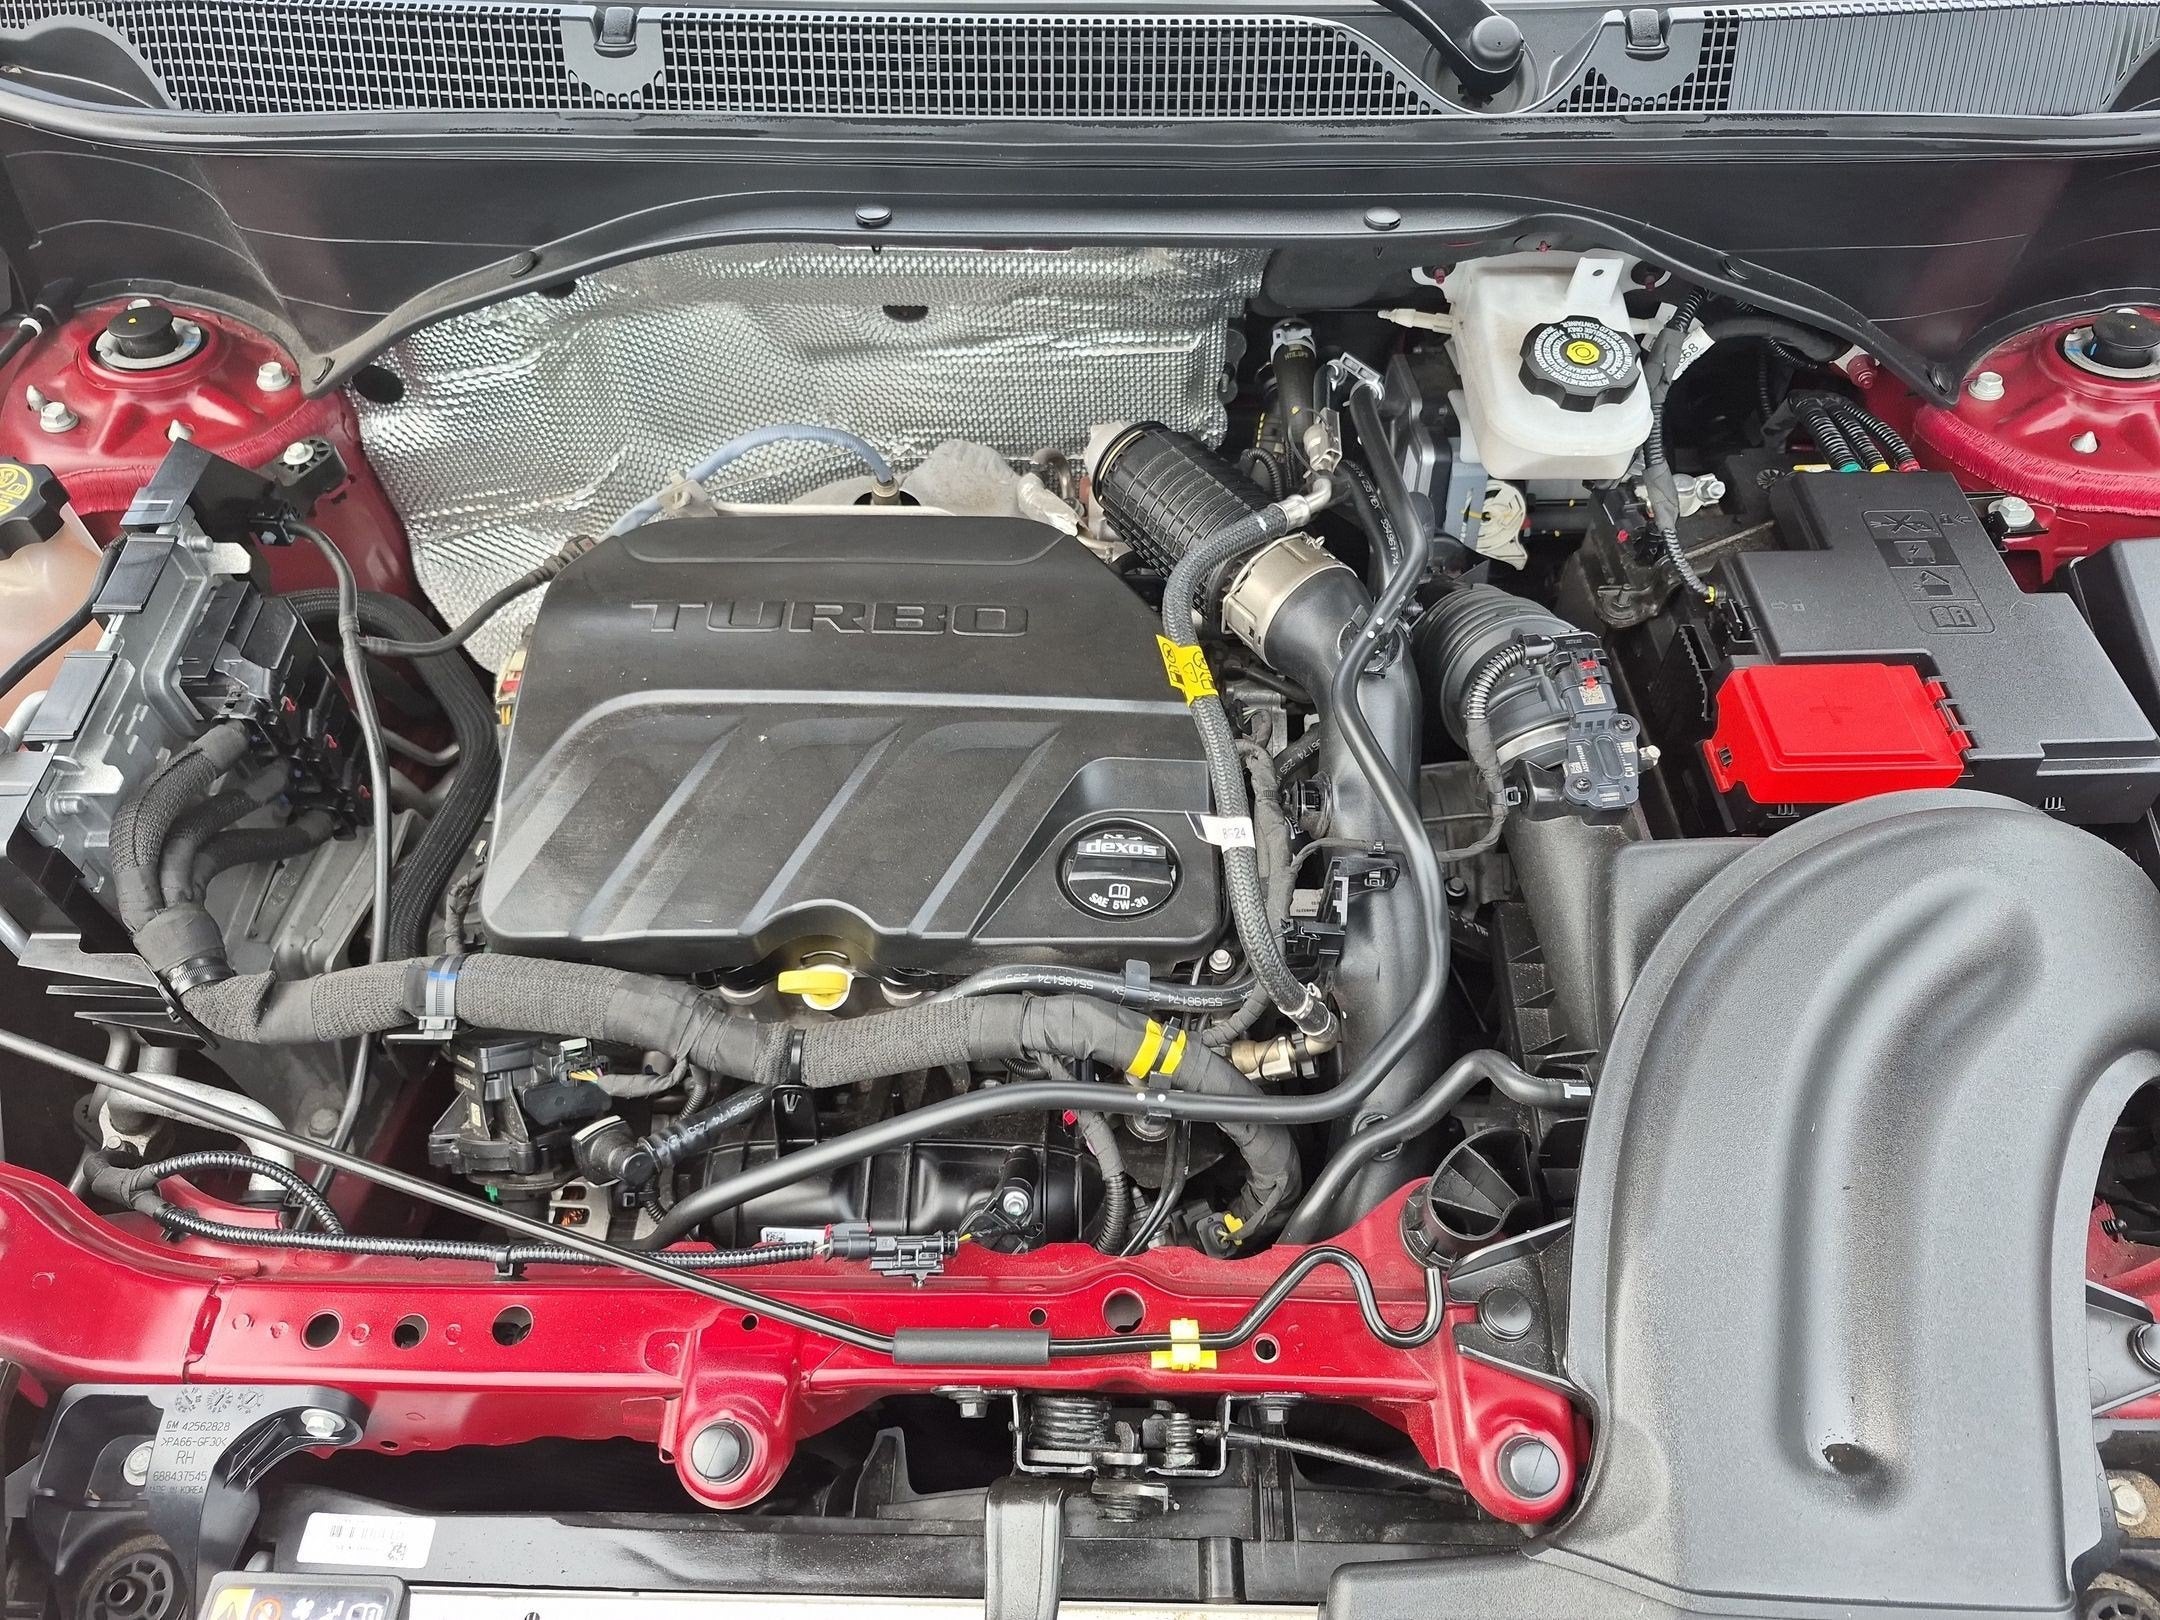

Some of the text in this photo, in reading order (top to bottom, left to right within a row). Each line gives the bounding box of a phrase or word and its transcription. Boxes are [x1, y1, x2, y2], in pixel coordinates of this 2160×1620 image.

[1599, 326, 1621, 340] SEALED
[1593, 336, 1611, 349] CLEAN
[1380, 518, 1401, 566] 55496174
[631, 600, 1028, 637] TURBO
[1085, 839, 1160, 856] dexos
[1088, 892, 1149, 910] SAE 5W-30
[1038, 973, 1095, 990] 55496174
[1167, 993, 1223, 1007] 55496174
[711, 1092, 764, 1126] 55496174
[165, 1420, 231, 1432] GM 42562828
[175, 1450, 196, 1465] RH
[152, 1470, 208, 1482] 688437545
[180, 1485, 204, 1494] KOREA
